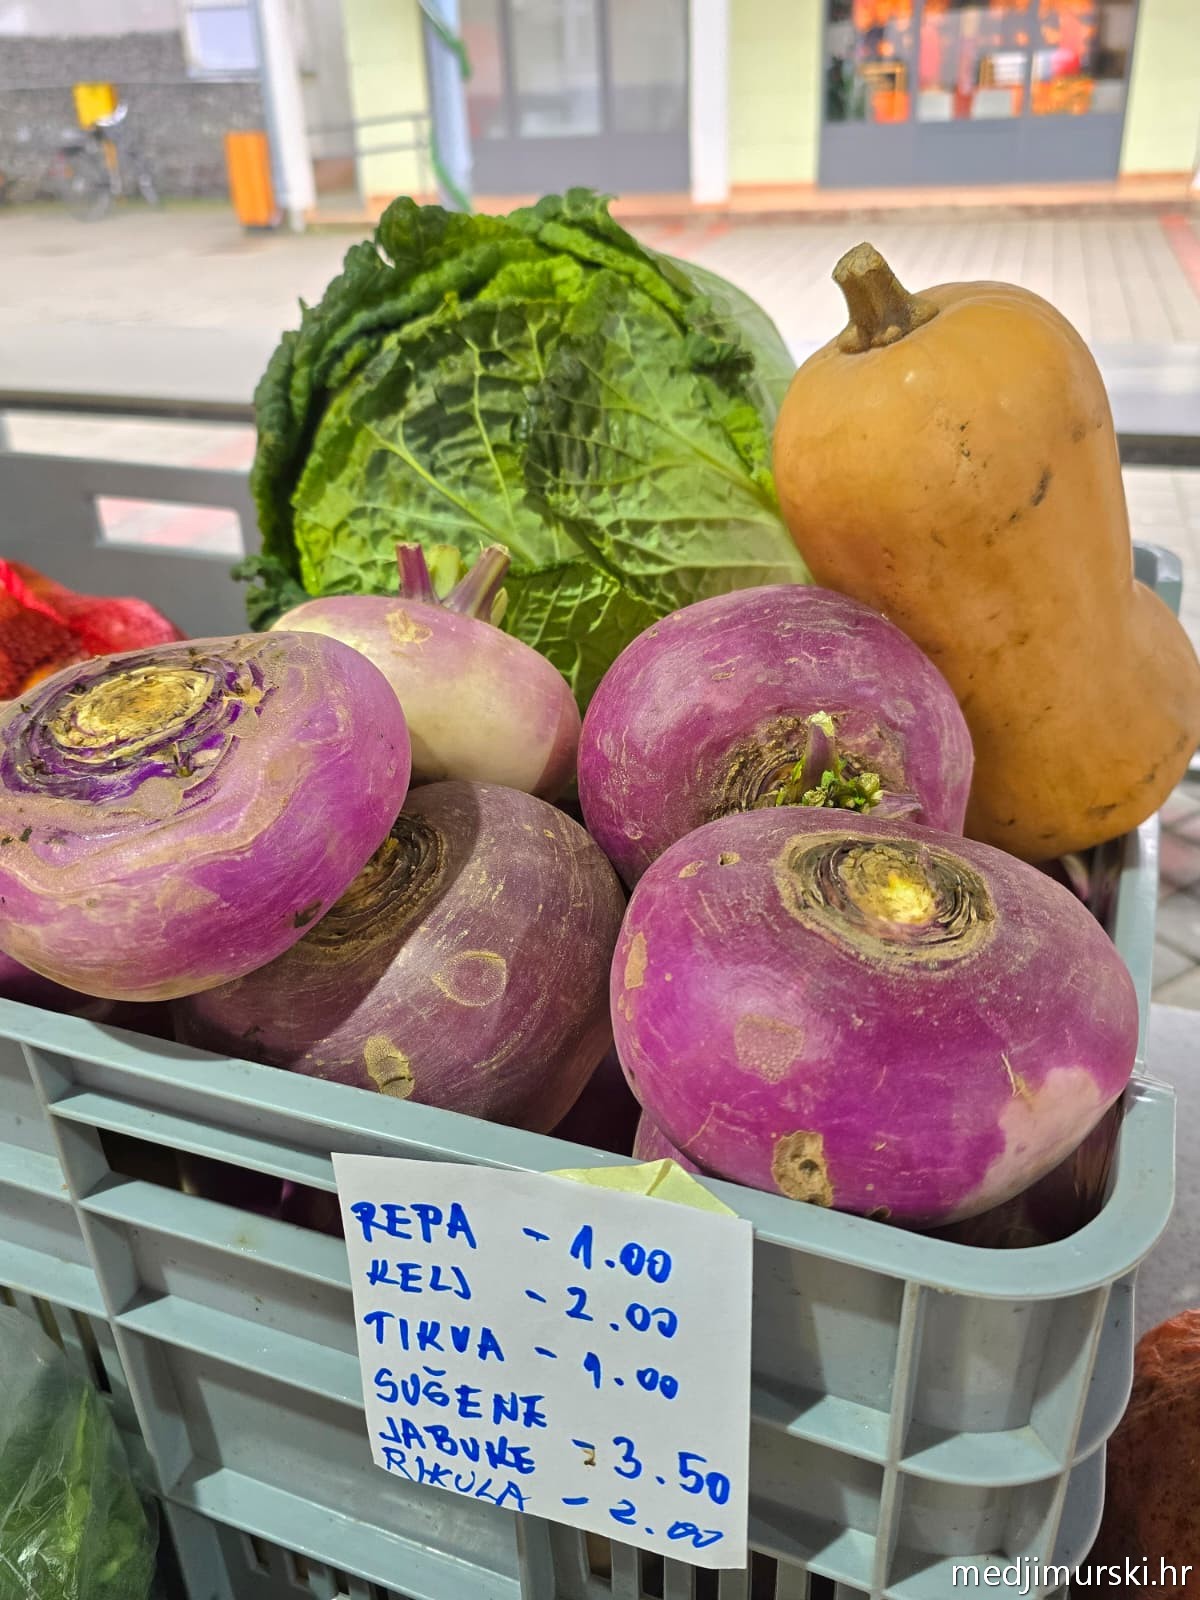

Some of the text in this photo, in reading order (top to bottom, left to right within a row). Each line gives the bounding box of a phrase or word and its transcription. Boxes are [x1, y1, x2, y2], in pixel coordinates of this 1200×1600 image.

[350, 1201, 478, 1249] REPA
[568, 1223, 674, 1284] 1.00
[363, 1310, 505, 1363] TIKVA
[366, 1258, 473, 1301] KELJ
[564, 1286, 680, 1339] 2.00
[373, 1366, 548, 1429] SUŠENE
[378, 1415, 536, 1476] JABUKE
[612, 1435, 732, 1506] 3.50
[381, 1446, 532, 1513] RIKULA
[608, 1498, 725, 1550] 2.00
